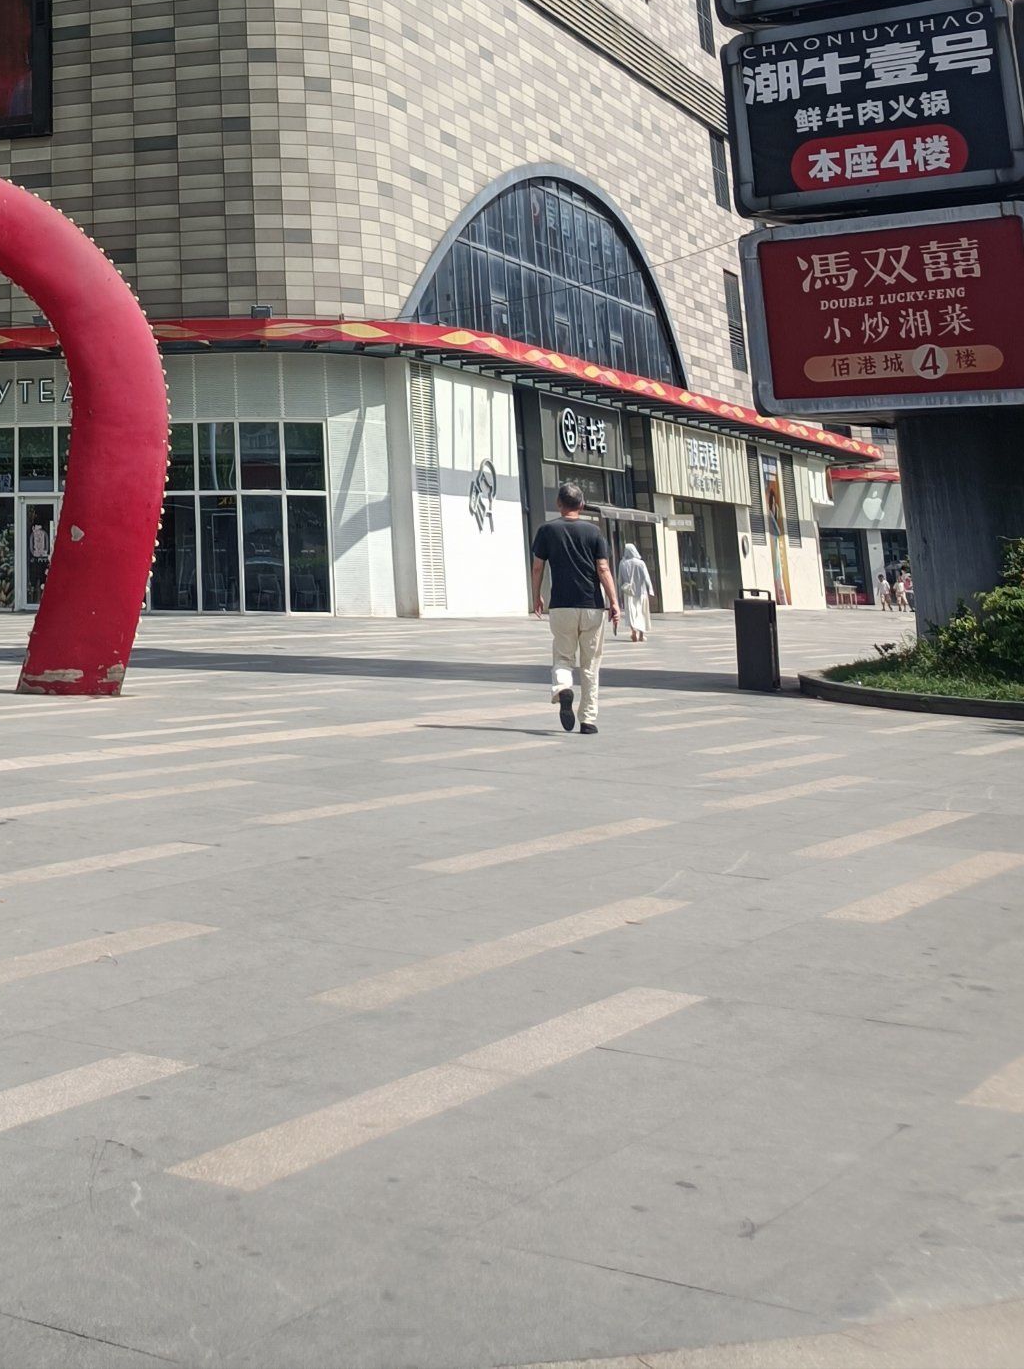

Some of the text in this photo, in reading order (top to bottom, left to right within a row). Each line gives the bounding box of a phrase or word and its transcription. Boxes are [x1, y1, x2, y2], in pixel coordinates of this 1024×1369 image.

[743, 11, 984, 60] CHAONIUYIHAO
[742, 28, 994, 106] 潮牛壹号
[794, 89, 951, 134] 鲜牛肉火锅
[807, 135, 952, 183] 本座4楼
[820, 295, 874, 311] DOUBLE
[824, 305, 975, 345] 小炒湘菜
